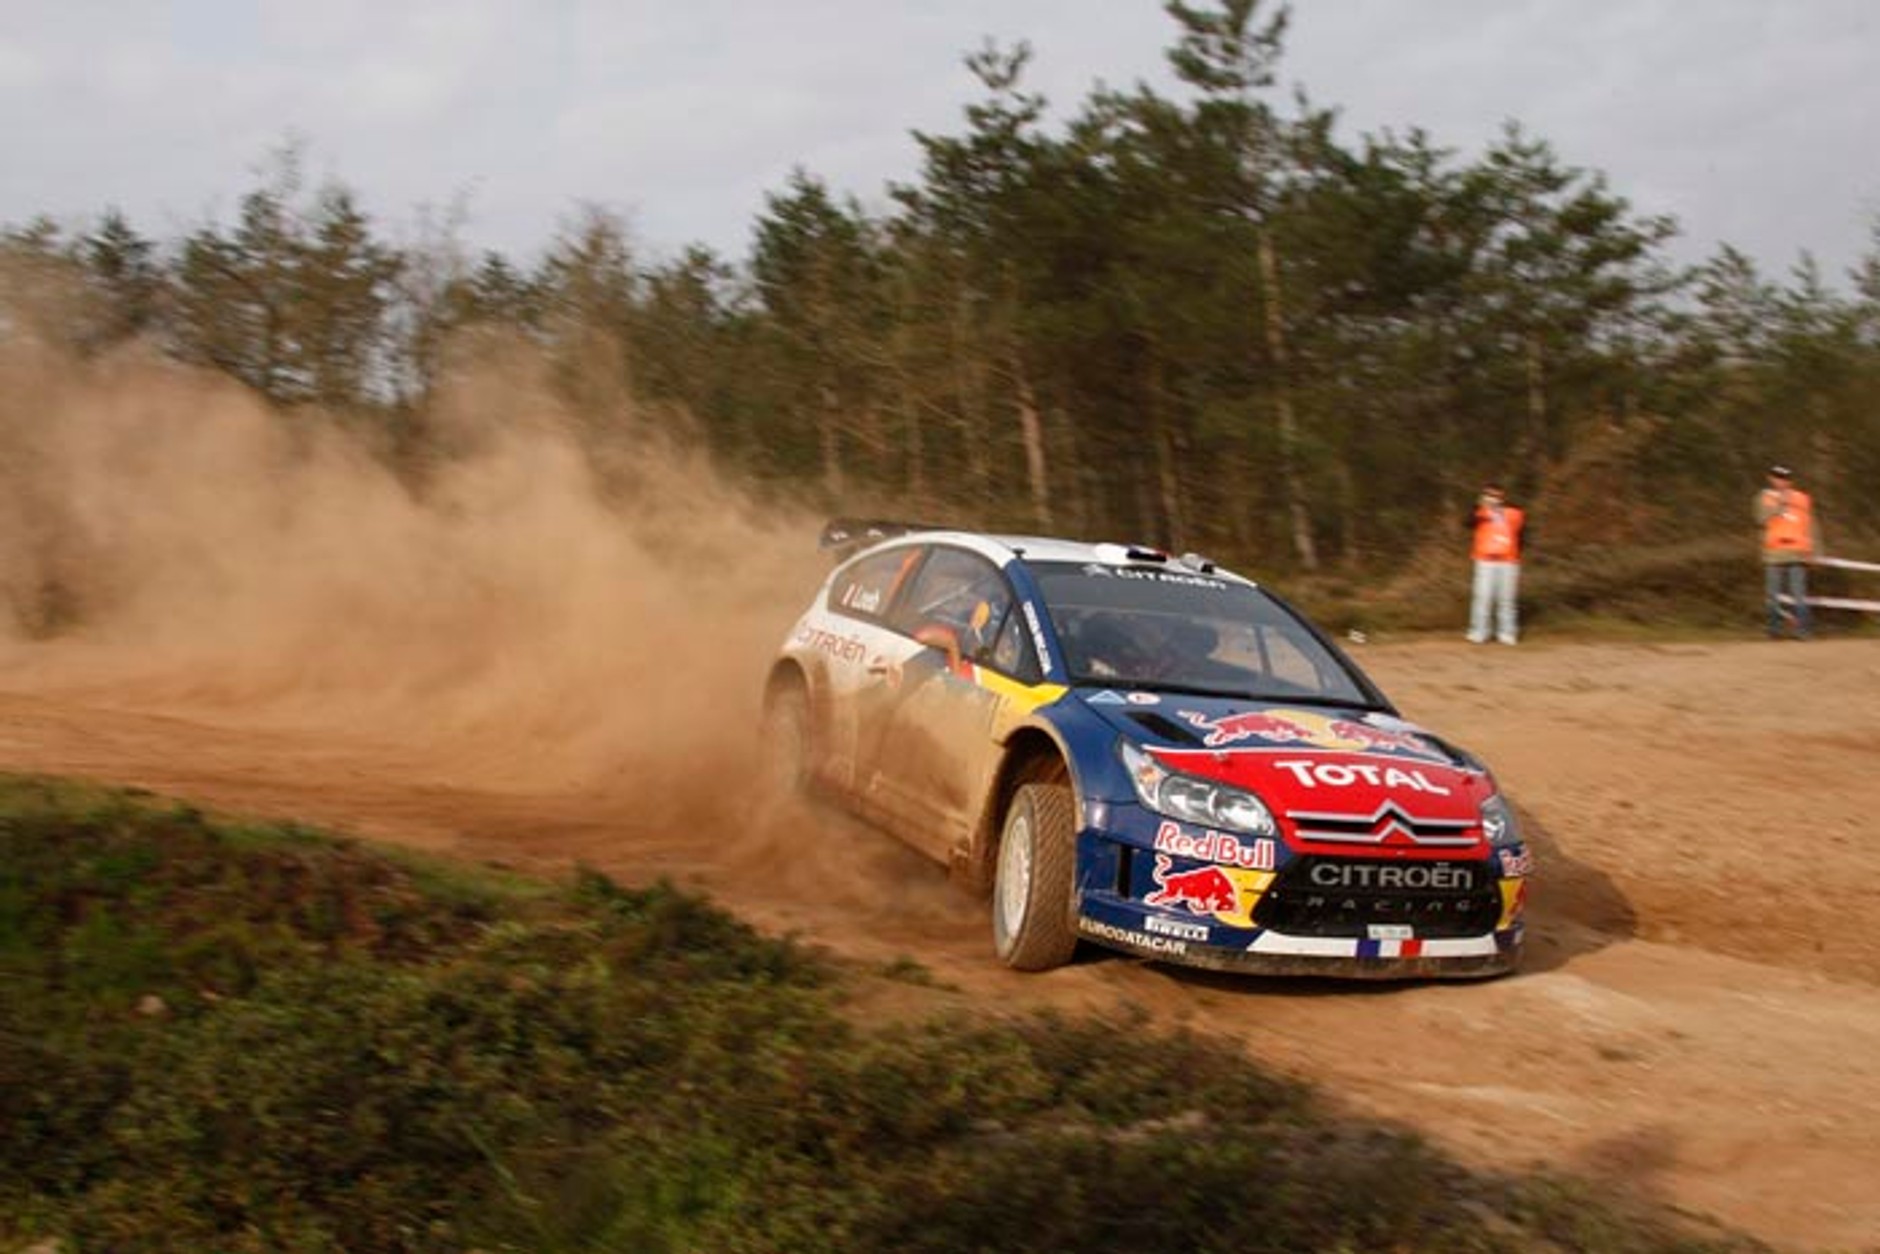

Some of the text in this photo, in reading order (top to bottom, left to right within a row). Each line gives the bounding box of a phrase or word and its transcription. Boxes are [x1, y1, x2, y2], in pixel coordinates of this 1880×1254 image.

[1274, 760, 1451, 796] TOTAL
[1156, 822, 1275, 869] Red Bull
[1080, 917, 1185, 955] EURODATACAR
